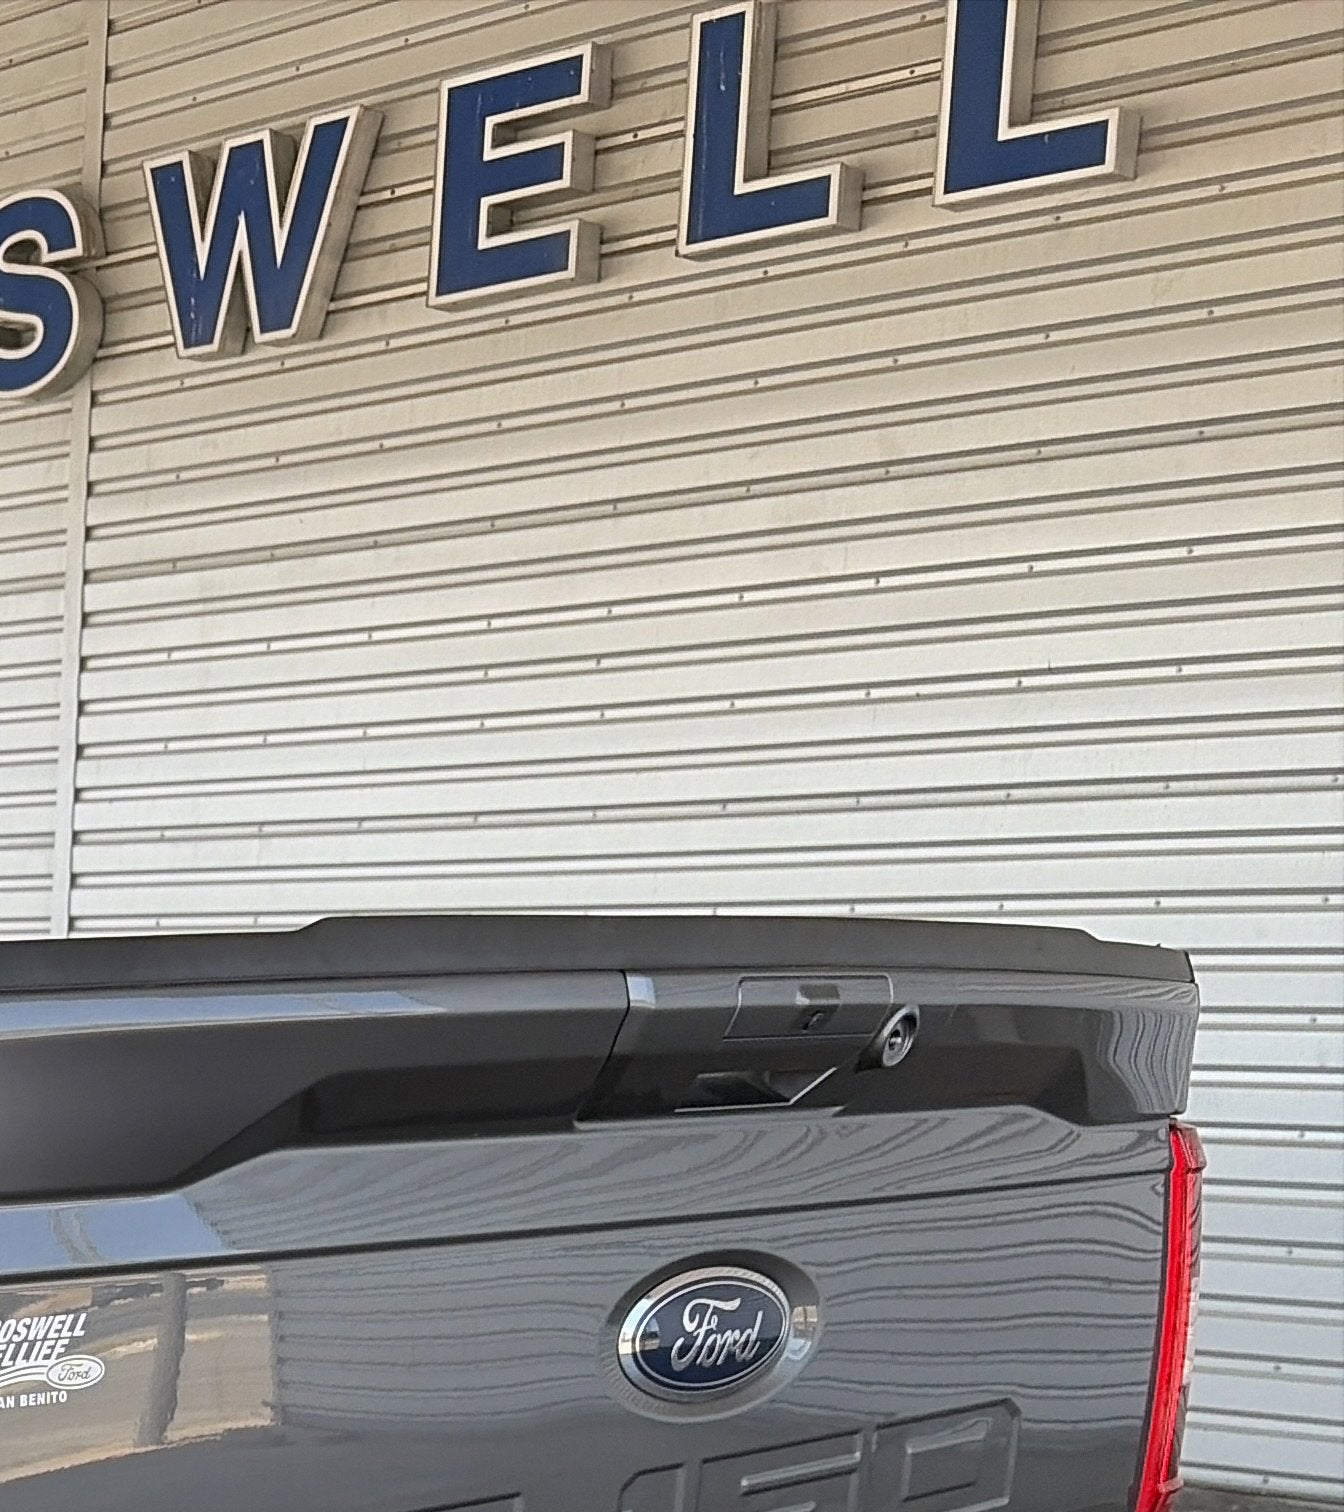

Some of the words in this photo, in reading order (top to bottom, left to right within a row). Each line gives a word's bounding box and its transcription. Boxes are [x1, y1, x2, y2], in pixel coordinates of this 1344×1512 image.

[670, 1297, 764, 1372] Ford
[57, 1363, 92, 1382] Ford
[19, 1390, 68, 1408] BENITO
